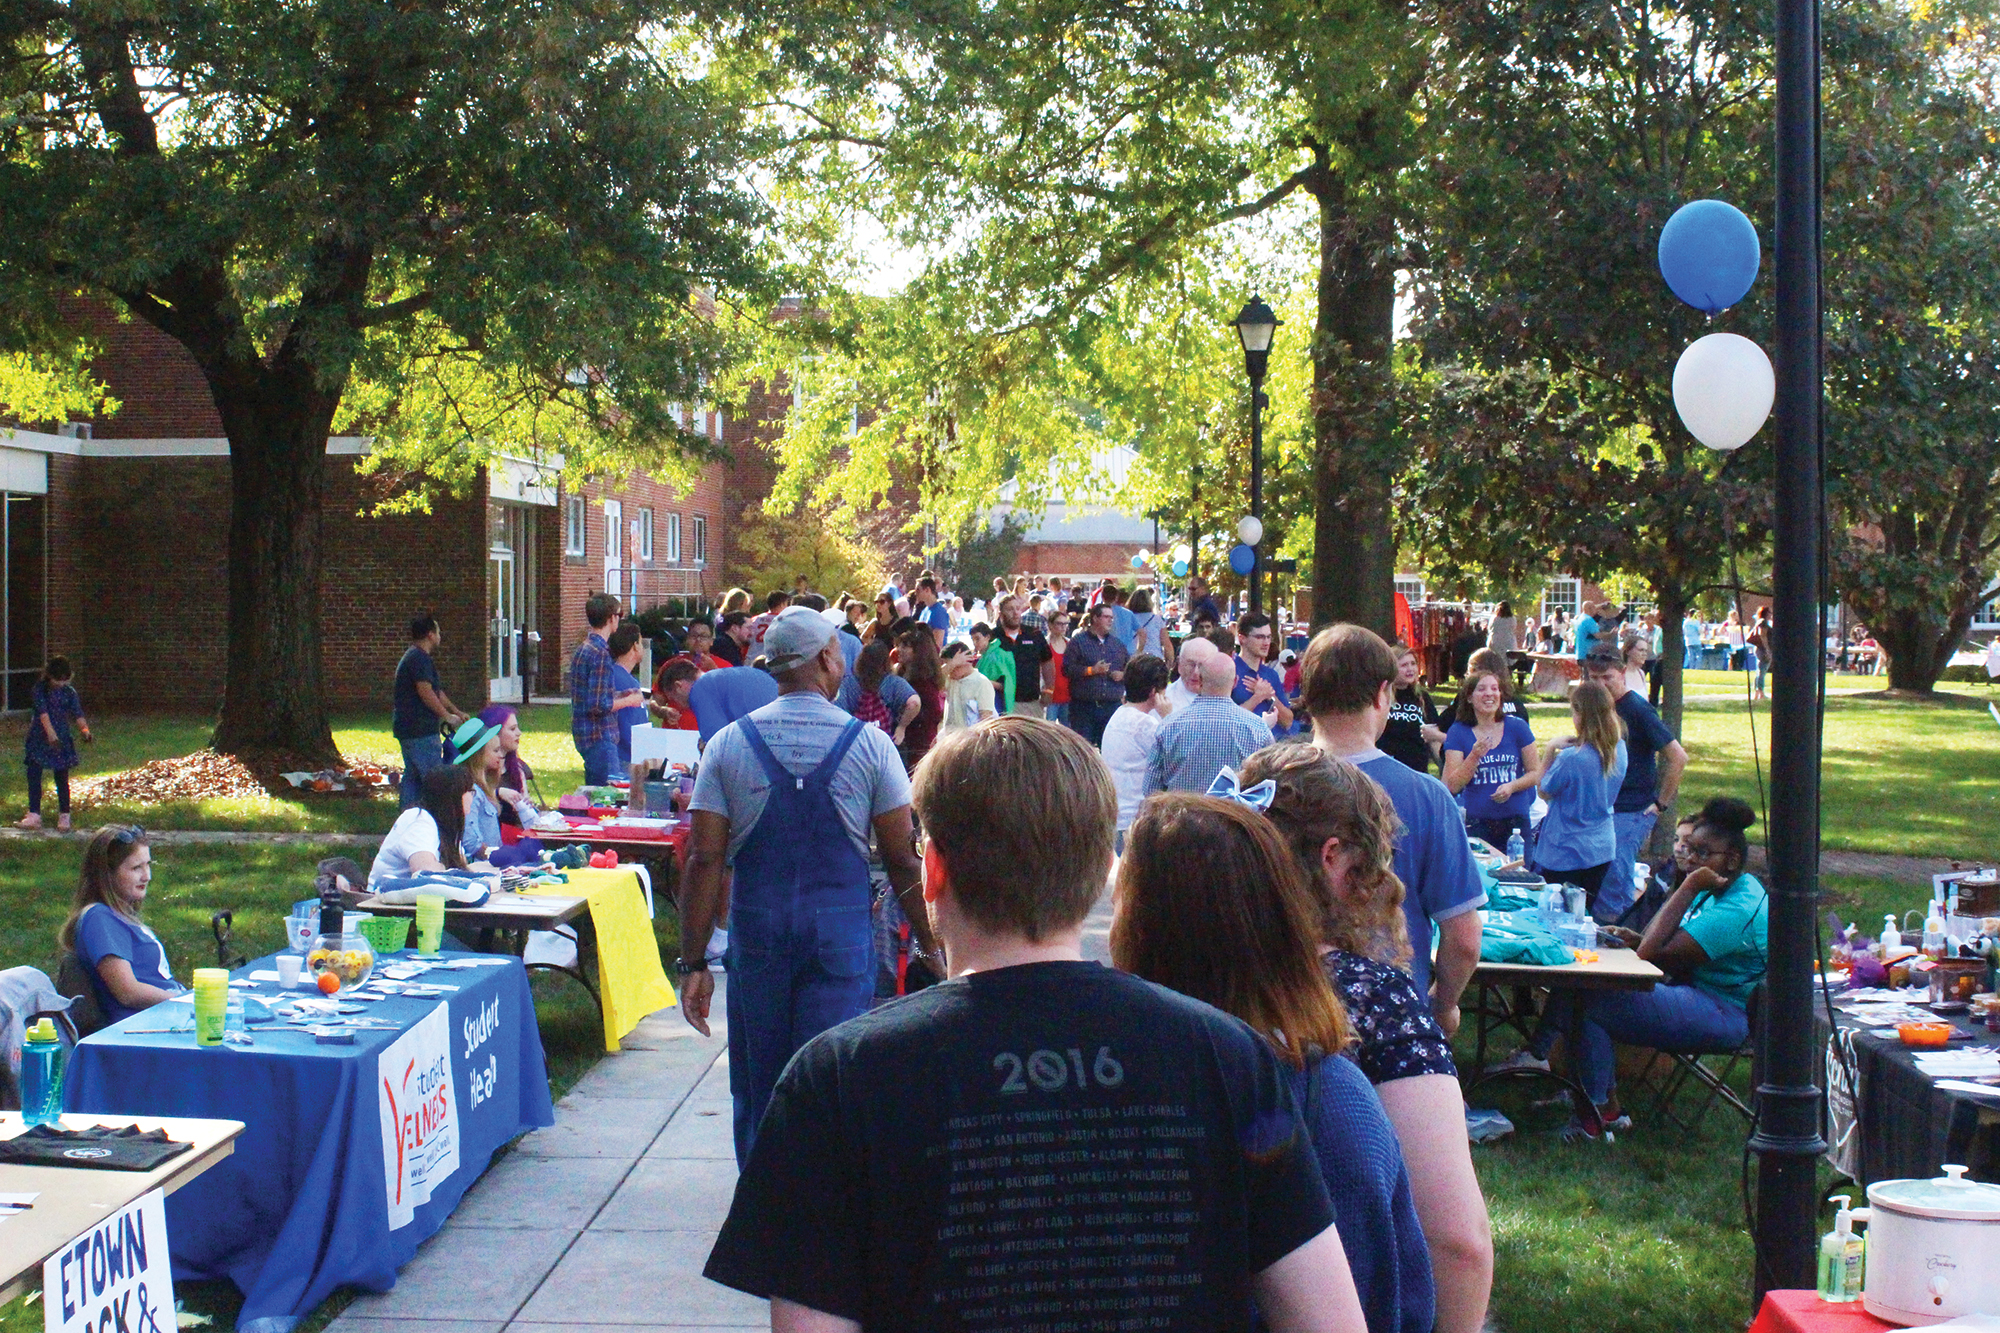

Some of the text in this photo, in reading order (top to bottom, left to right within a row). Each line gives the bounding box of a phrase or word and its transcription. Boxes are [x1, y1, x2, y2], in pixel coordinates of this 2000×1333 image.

[1477, 754, 1515, 765] LUEJAYS
[993, 1045, 1125, 1095] 2016
[60, 1208, 148, 1325] ETOWN
